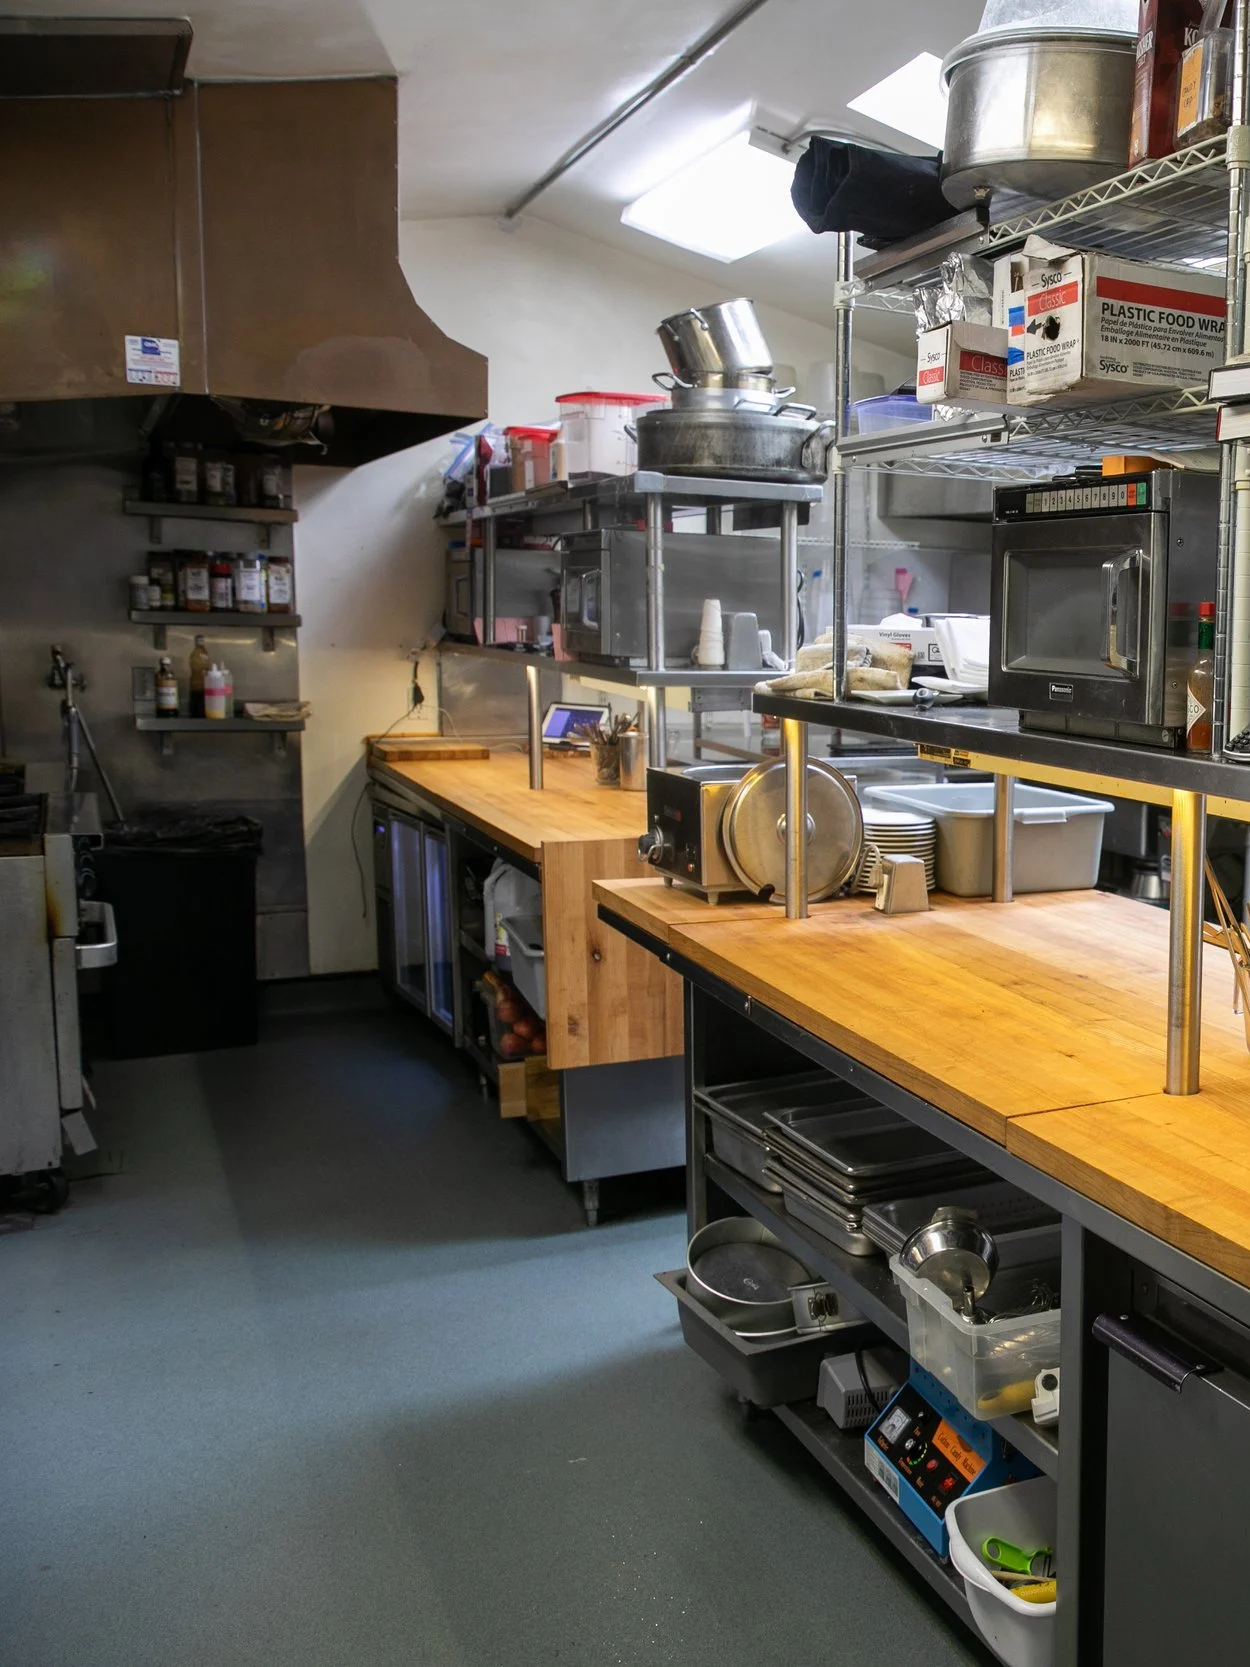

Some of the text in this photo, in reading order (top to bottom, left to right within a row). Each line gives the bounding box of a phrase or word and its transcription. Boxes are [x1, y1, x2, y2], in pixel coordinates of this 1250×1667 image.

[1041, 272, 1062, 289] Sysco
[1039, 289, 1067, 311] Classic
[1100, 316, 1120, 327] Papel
[1119, 319, 1128, 327] de
[1152, 325, 1168, 334] para
[1168, 327, 1195, 338] Envolver
[1101, 302, 1225, 333] PLASTIC FOOD WRA
[1100, 325, 1134, 337] Emballage
[1134, 331, 1171, 342] Alimentaire
[1179, 337, 1208, 349] Plastique
[1100, 334, 1109, 342] 18
[1123, 338, 1141, 347] 2000
[1150, 342, 1171, 352] (45.72
[1187, 347, 1205, 356] 609.6
[1205, 350, 1214, 358] m)
[927, 352, 941, 364] Sysco
[1026, 346, 1046, 360] PLASTIC
[1046, 343, 1061, 355] FOOD
[1061, 338, 1076, 350] WRAP
[971, 354, 1007, 376] Classi
[1009, 366, 1026, 378] PLASTI
[1099, 359, 1127, 373] Sysco
[922, 369, 941, 385] Classic
[950, 1444, 963, 1462] Candy
[962, 1458, 977, 1477] Machine
